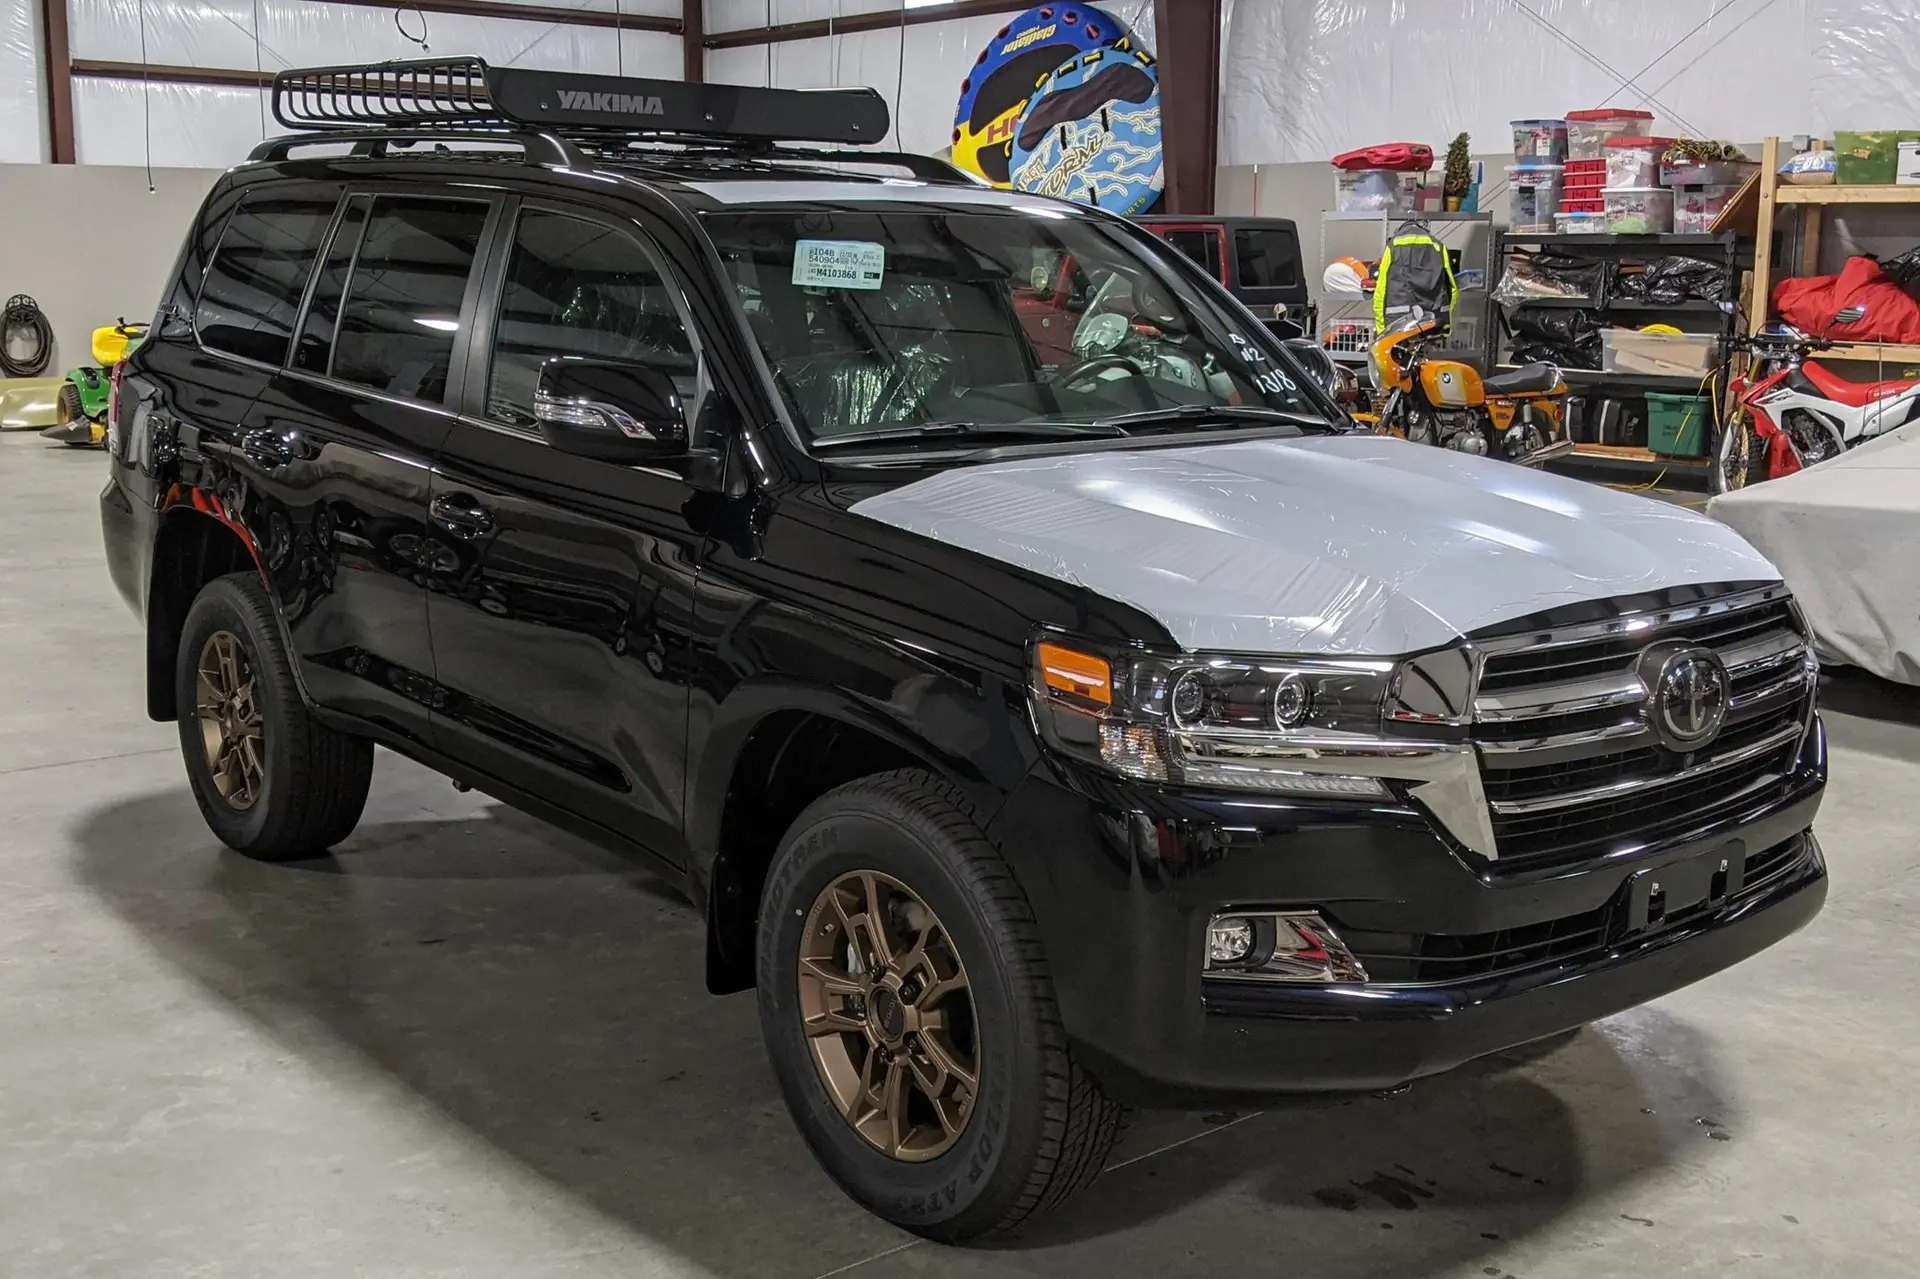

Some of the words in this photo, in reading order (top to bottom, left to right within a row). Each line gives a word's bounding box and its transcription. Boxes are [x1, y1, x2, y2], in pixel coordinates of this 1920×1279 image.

[1000, 23, 1057, 56] Gladiator
[1016, 25, 1040, 39] HERO
[556, 89, 665, 116] YAKIMA
[816, 268, 857, 279] M4103868
